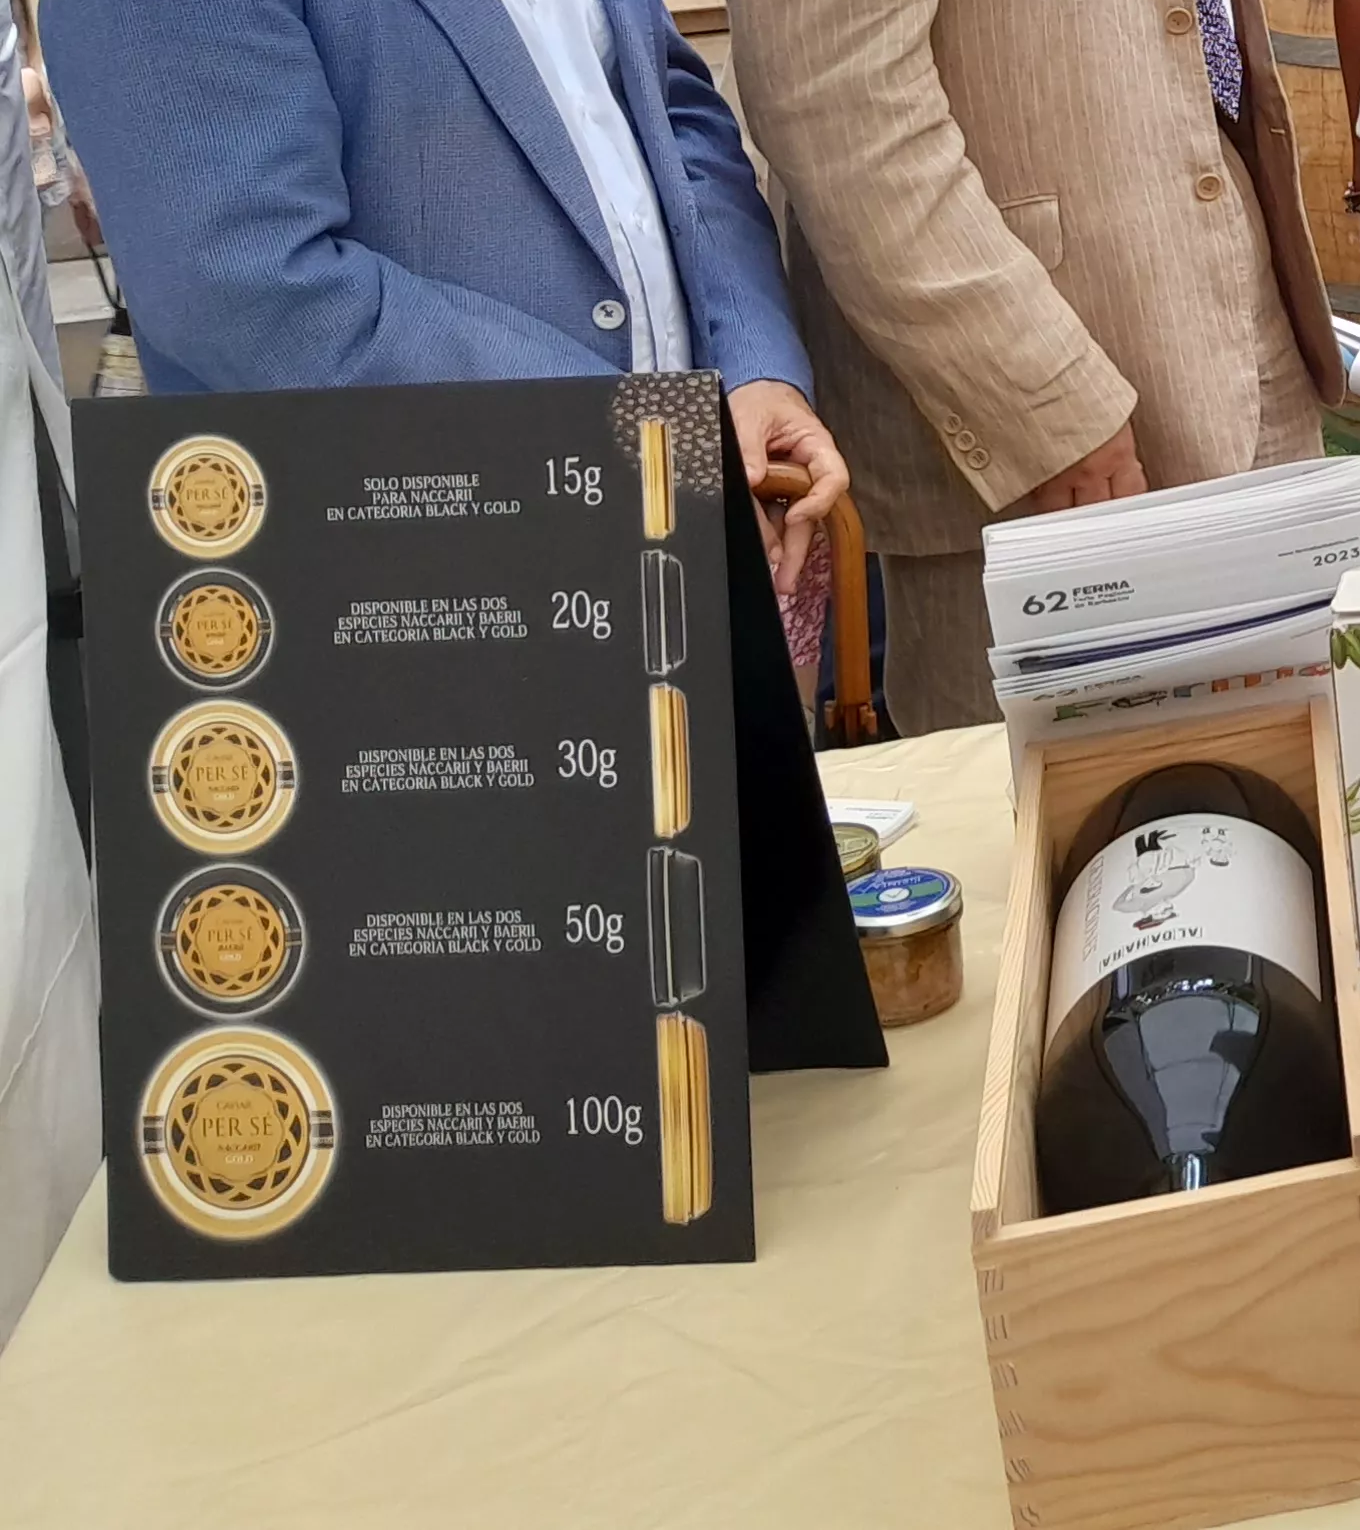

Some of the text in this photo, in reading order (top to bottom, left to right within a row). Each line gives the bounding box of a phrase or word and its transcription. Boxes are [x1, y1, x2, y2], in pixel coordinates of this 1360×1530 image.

[364, 474, 480, 491] SOLO DISPONIBLE
[546, 457, 603, 506] 15g
[372, 489, 473, 505] PARA NACCARII
[327, 507, 344, 521] EN
[425, 502, 468, 517] BLACK
[471, 502, 480, 515] Y
[484, 500, 520, 514] GOLD
[1312, 546, 1360, 568] 2023
[350, 596, 507, 615] DISPONIBLE EN LAS DOS
[1022, 580, 1129, 616] 62 FERMA
[338, 615, 398, 631] ESPECIES
[401, 613, 462, 628] NACCARII
[466, 612, 475, 625] Y
[551, 590, 612, 639] 20g
[334, 631, 351, 644] EN
[433, 626, 475, 640] BLACK
[479, 626, 488, 638] Y
[491, 624, 528, 638] GOLD
[358, 745, 515, 764] DISPONIBLE EN LAS DOS
[558, 738, 618, 788] 30g
[196, 766, 227, 782] PER
[346, 764, 406, 779] ESPECIES
[408, 762, 470, 776] NACCARII
[474, 761, 483, 773] Y
[341, 780, 358, 793] EN
[440, 775, 483, 789] BLACK
[486, 775, 496, 787] Y
[498, 774, 535, 787] GOLD
[366, 910, 522, 928] DISPONIBLE EN LAS DOS
[207, 928, 234, 943] PER
[353, 928, 413, 943] ESPECIES
[416, 926, 478, 940] NACCARII
[481, 926, 490, 938] Y
[566, 904, 625, 954] 50g
[349, 944, 366, 957] EN
[448, 940, 490, 953] BLACK
[493, 939, 502, 952] Y
[506, 938, 542, 952] GOLD
[382, 1101, 523, 1119] DISPONIBLE EN LAS DOS
[203, 1110, 274, 1137] PER SÉ
[370, 1119, 424, 1134] ESPECIES
[427, 1118, 483, 1131] NACCARII
[486, 1117, 495, 1130] Y
[566, 1095, 644, 1145] 100g
[365, 1134, 382, 1148] EN
[455, 1130, 494, 1144] BLACK
[497, 1130, 505, 1143] Y
[507, 1129, 541, 1143] GOLD
[225, 1155, 254, 1164] GOLD
